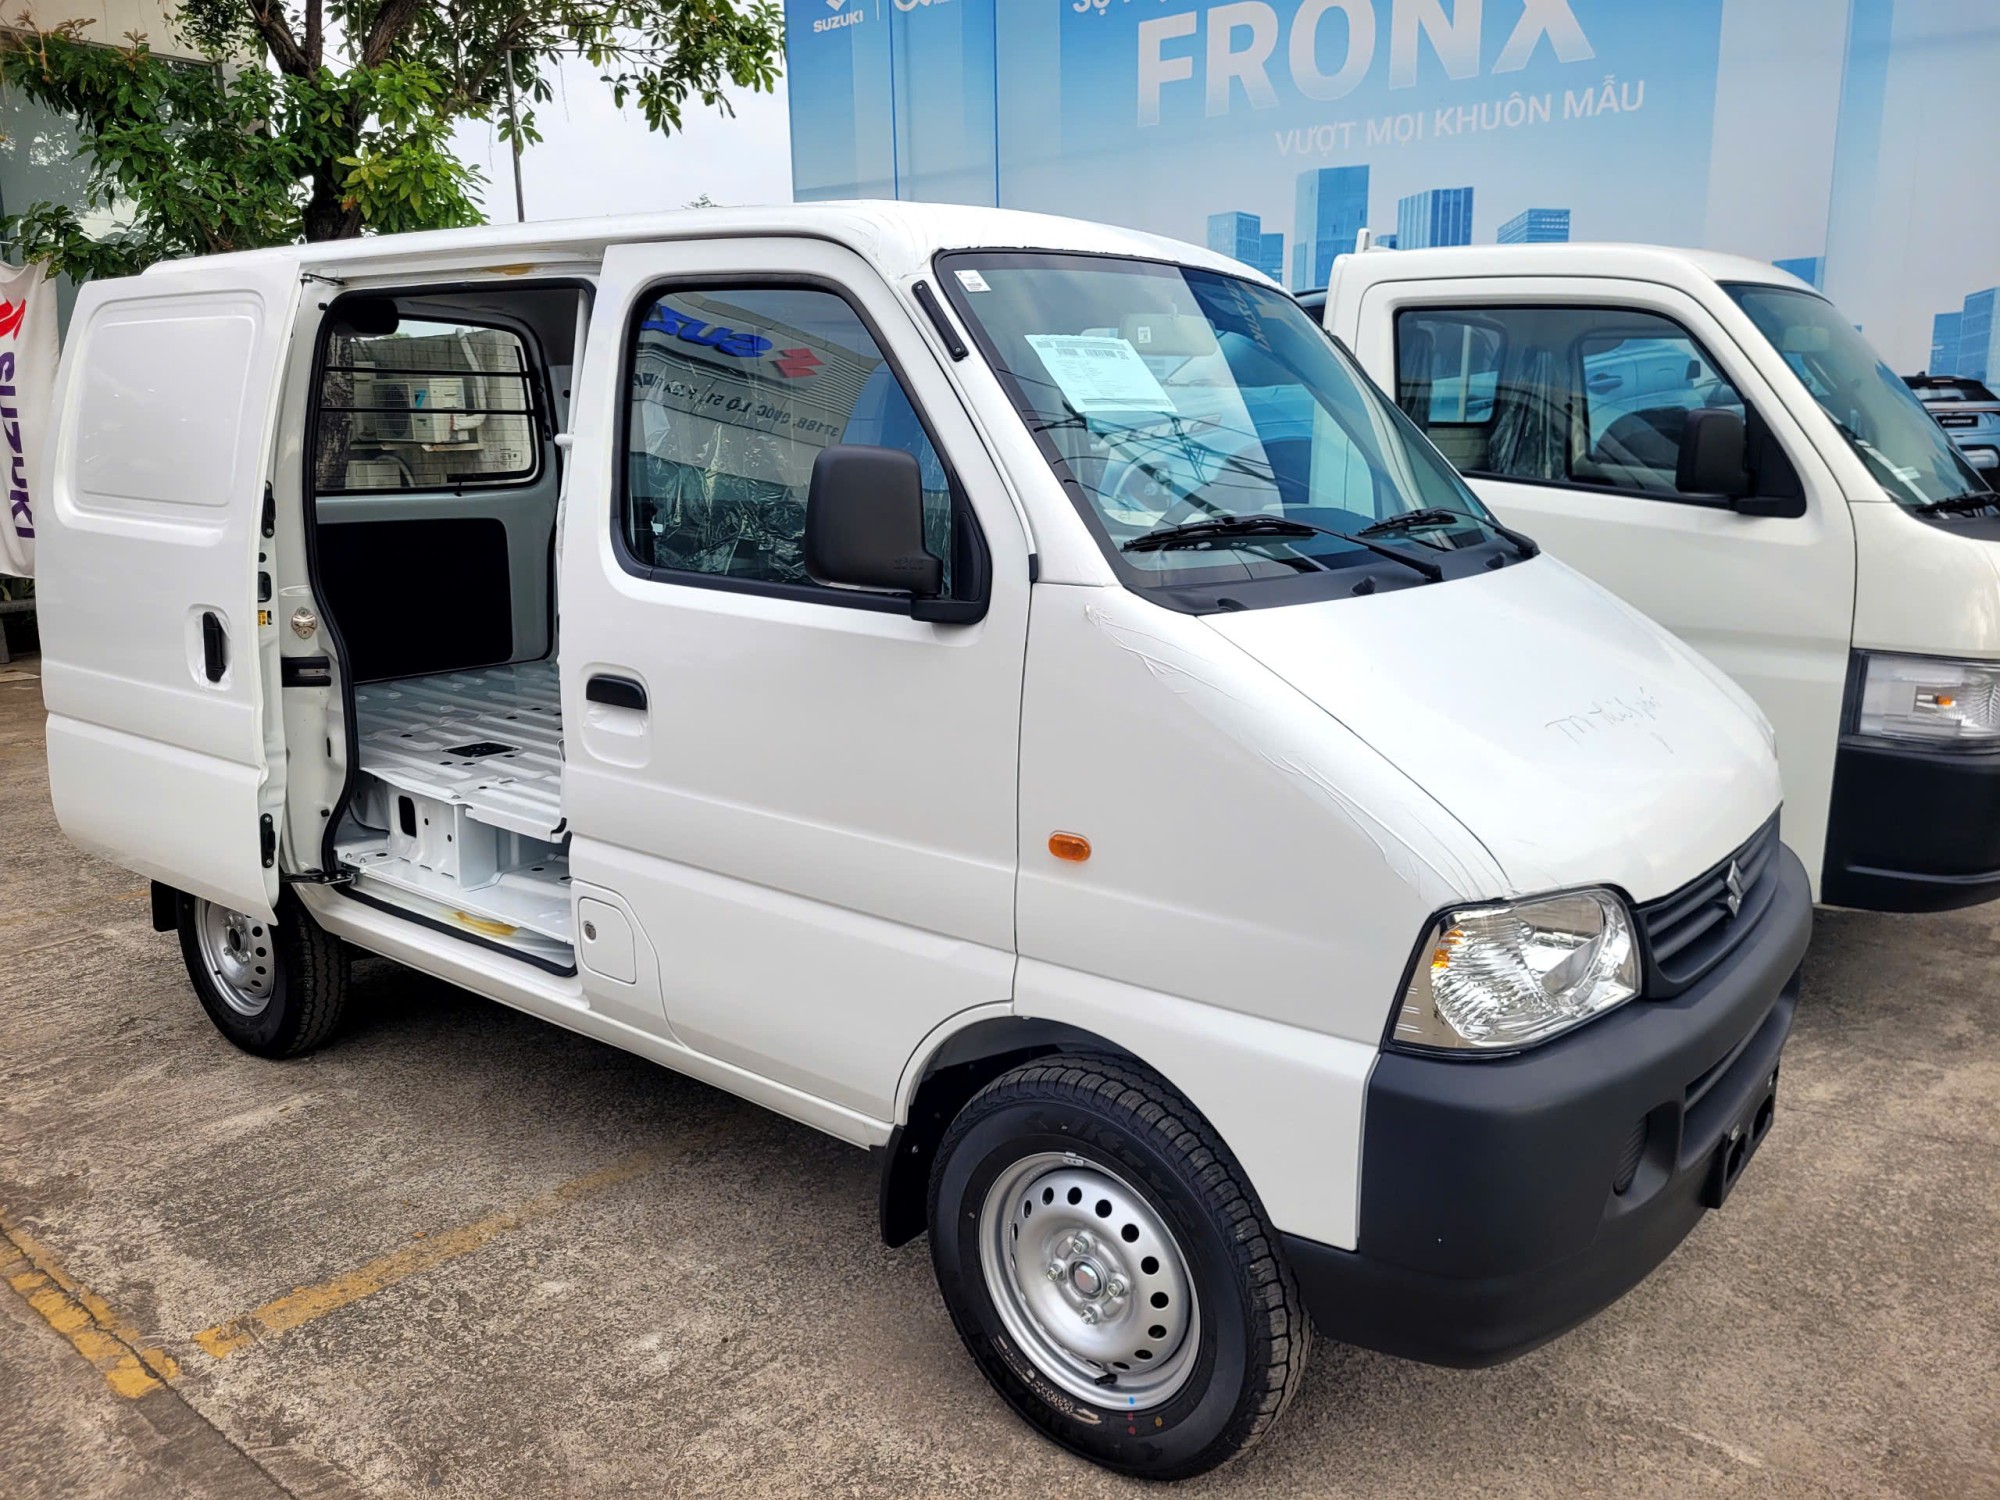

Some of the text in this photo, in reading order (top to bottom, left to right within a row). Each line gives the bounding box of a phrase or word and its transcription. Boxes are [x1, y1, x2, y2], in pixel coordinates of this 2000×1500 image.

[813, 10, 865, 33] SUZUKI
[1136, 0, 1596, 127] FRONX
[1275, 74, 1646, 157] VƯỢT MỌI KHUÔN MẪU
[0, 351, 36, 539] SUZUKI
